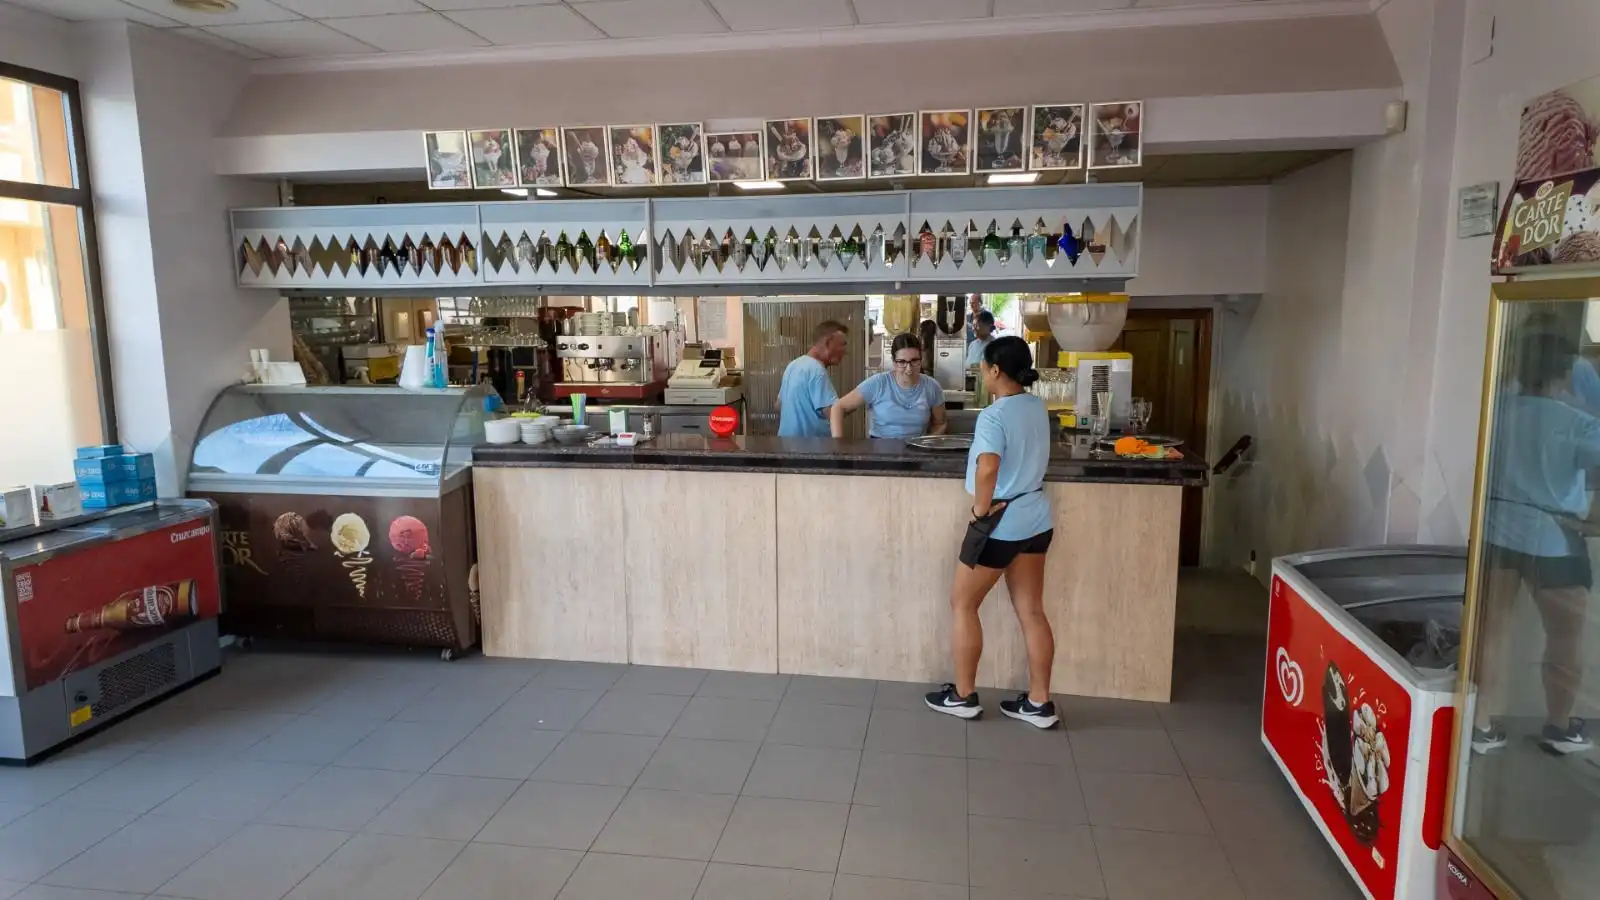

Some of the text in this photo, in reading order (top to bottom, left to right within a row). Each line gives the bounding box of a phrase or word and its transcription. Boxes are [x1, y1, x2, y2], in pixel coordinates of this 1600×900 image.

[1514, 191, 1565, 228] CARTE
[1522, 214, 1561, 246] D'OR
[170, 524, 210, 544] Cruzcampo
[220, 531, 249, 547] RTE
